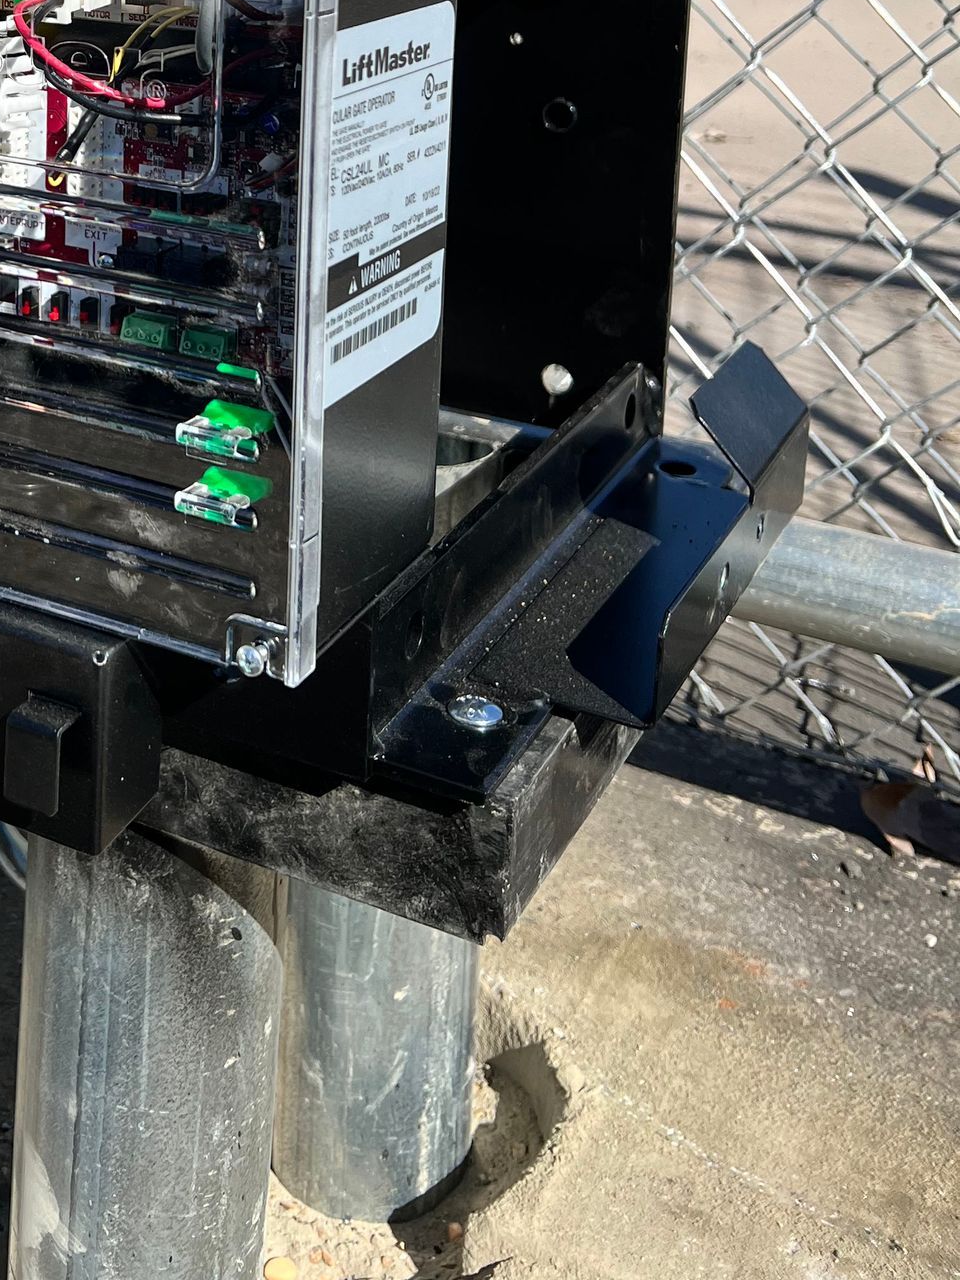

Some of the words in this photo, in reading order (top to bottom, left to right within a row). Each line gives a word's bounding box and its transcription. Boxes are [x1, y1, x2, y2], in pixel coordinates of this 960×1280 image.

[342, 40, 431, 87] LiftMaster
[353, 100, 368, 118] GATE
[368, 90, 396, 113] OPERATOR
[340, 160, 374, 184] CSL24UL
[378, 152, 391, 169] MC
[84, 229, 107, 241] EXIT
[360, 249, 401, 288] WARNING
